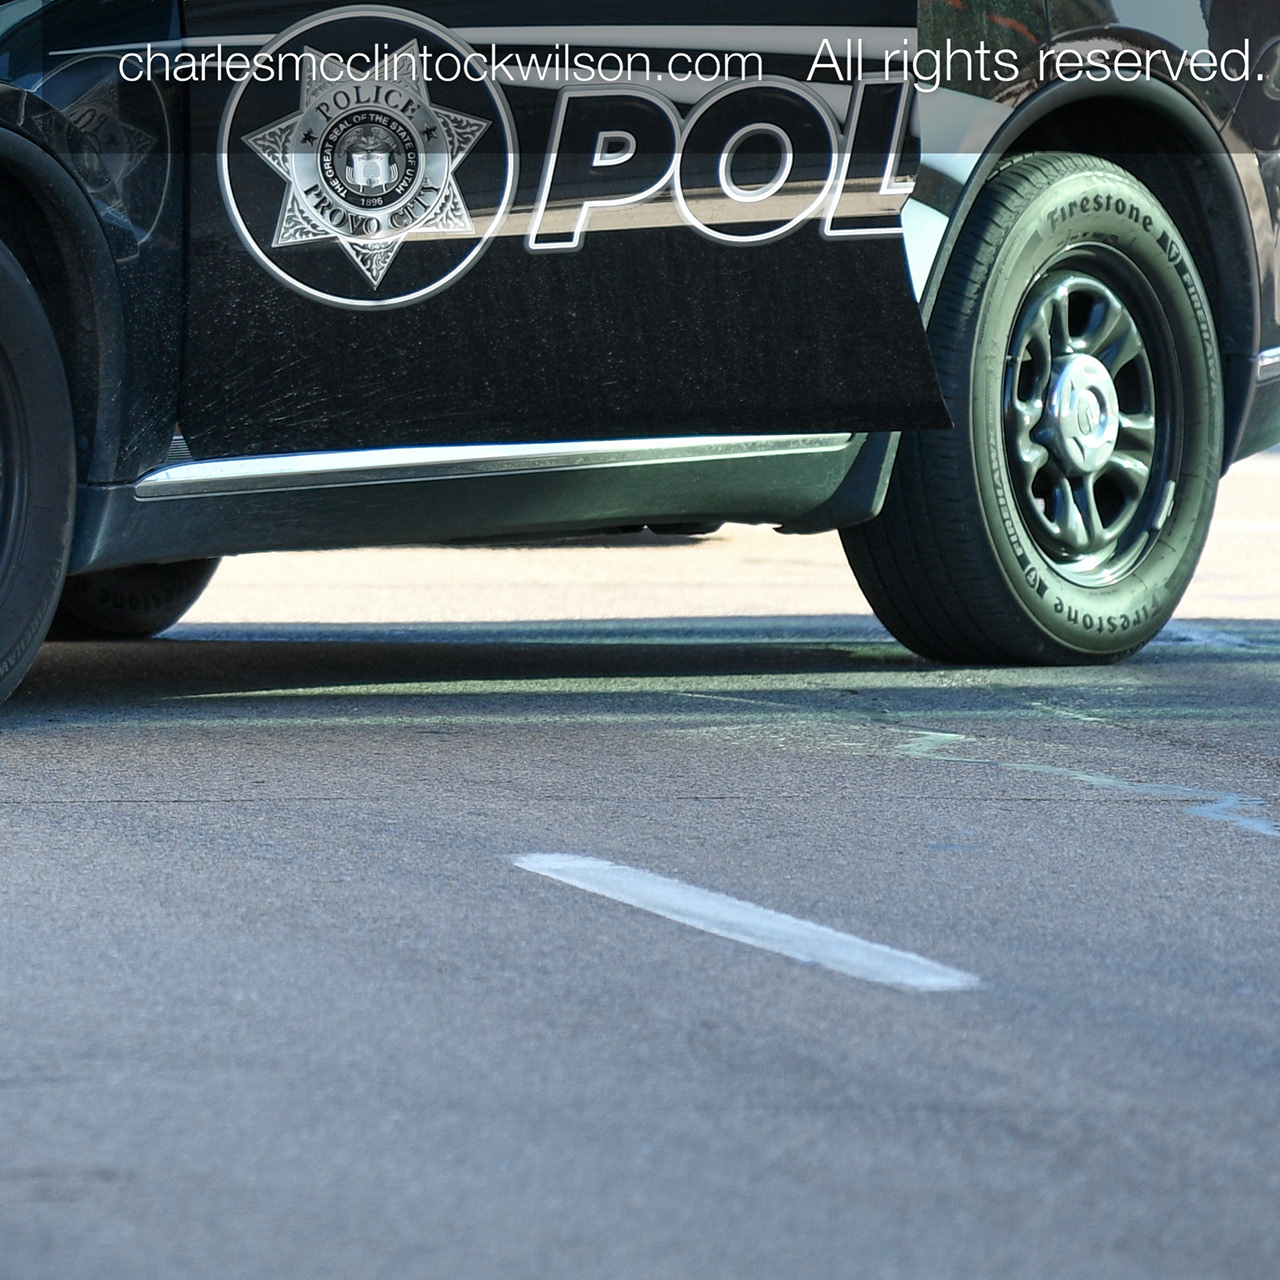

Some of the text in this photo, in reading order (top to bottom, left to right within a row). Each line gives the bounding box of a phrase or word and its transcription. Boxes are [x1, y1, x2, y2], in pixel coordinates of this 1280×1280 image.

[315, 84, 422, 123] POLICE
[323, 113, 417, 198] THE GREAT SEAL OF THE STATE OF UTAH
[304, 175, 441, 235] PROVO CITY
[360, 197, 384, 206] 1896
[1046, 193, 1154, 233] Firestone
[988, 427, 1025, 558] FIREHAWK
[1053, 584, 1165, 634] Firestone
